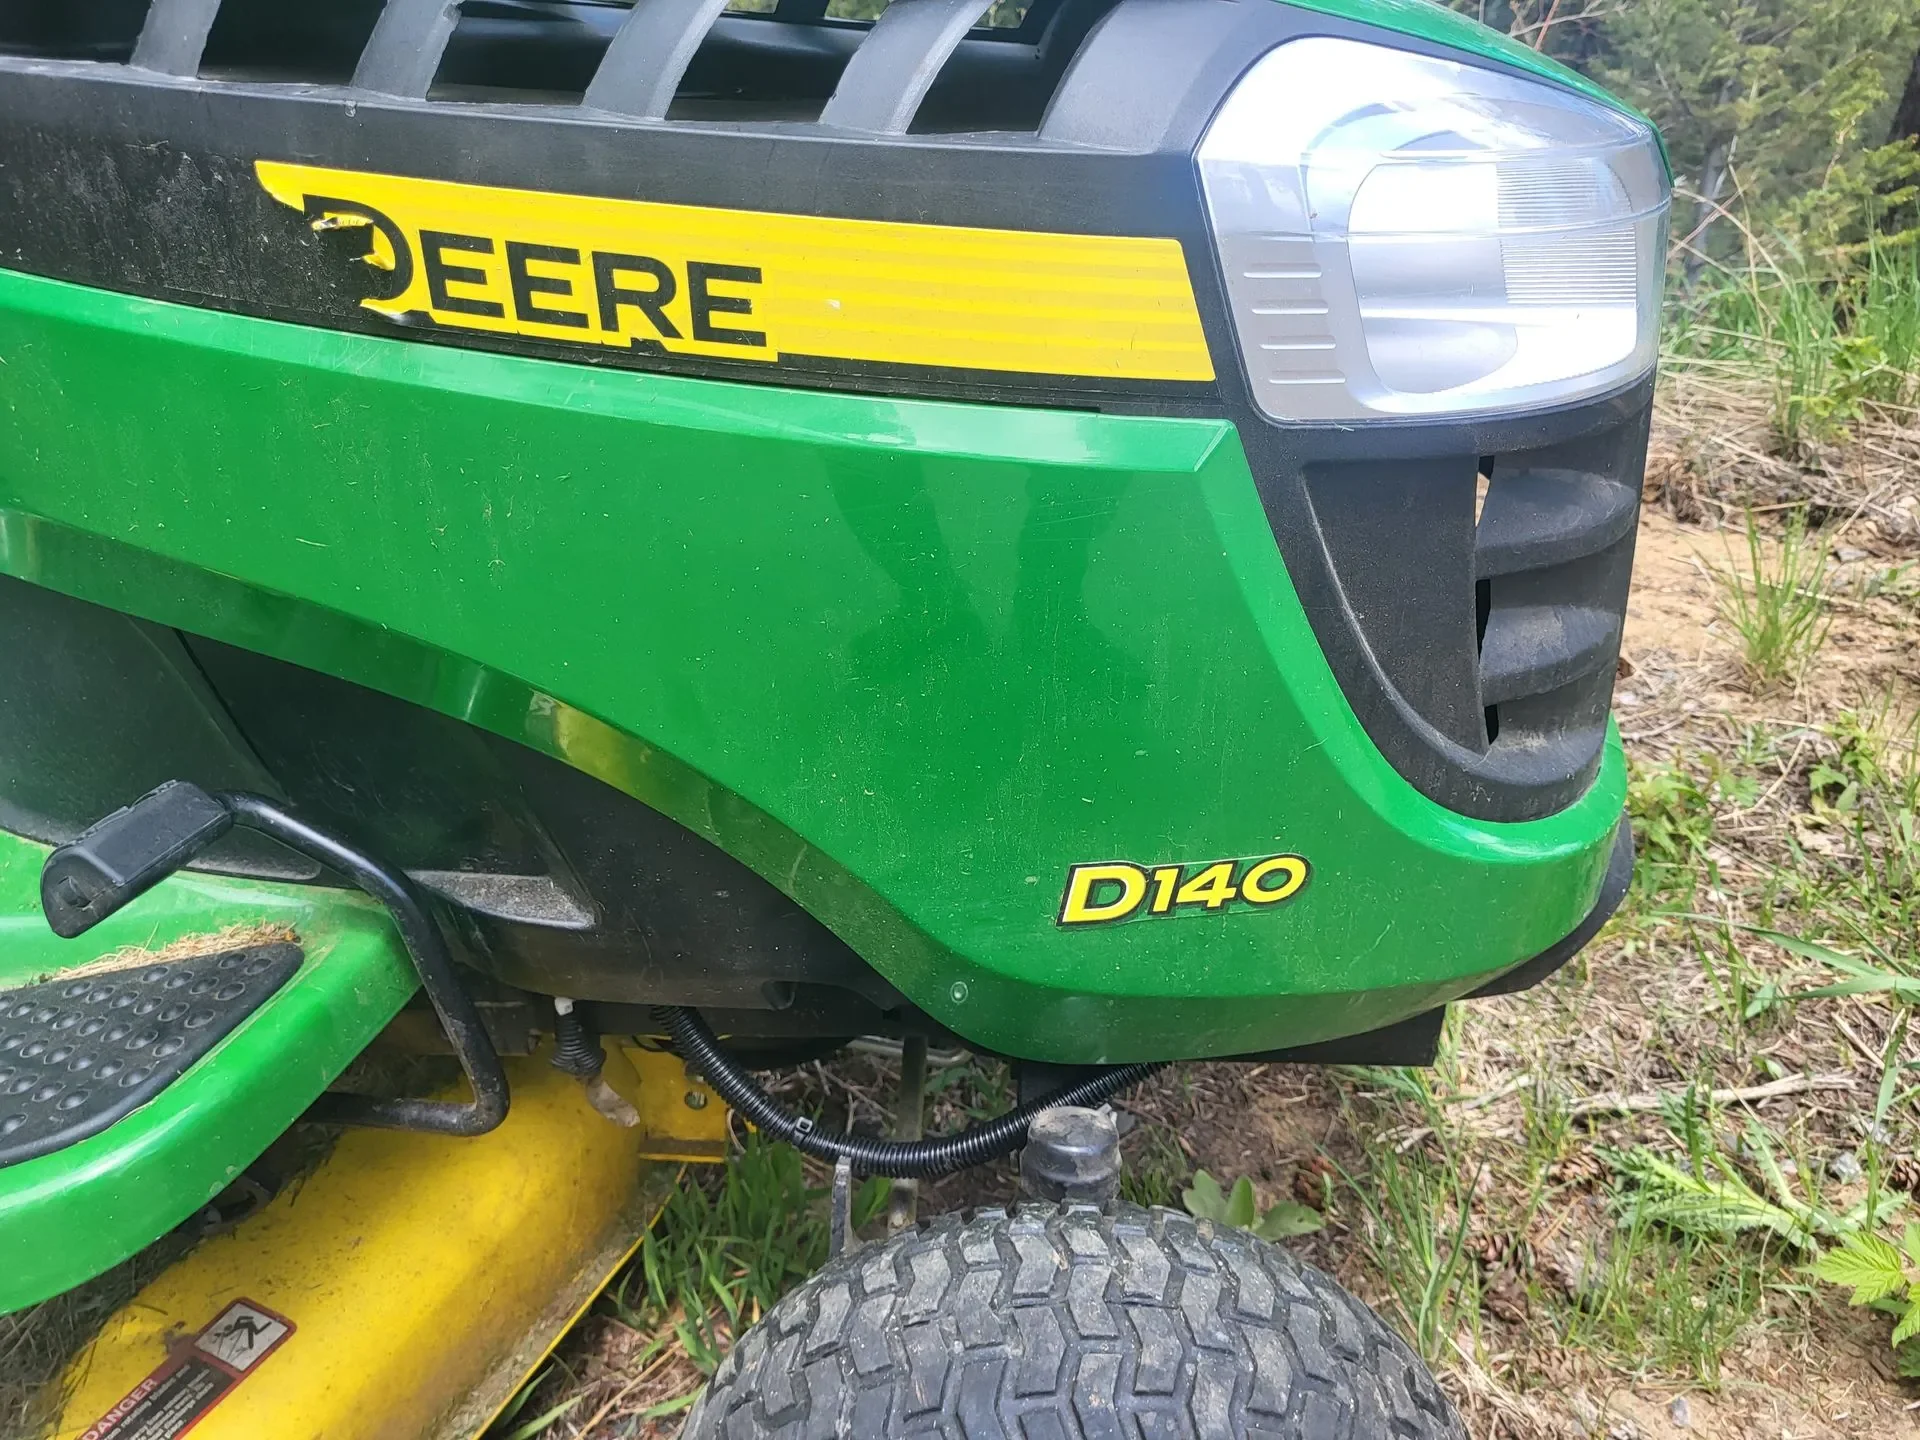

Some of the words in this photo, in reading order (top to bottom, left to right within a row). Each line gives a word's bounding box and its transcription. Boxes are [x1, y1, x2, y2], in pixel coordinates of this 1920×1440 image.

[303, 194, 767, 347] DEERE
[1057, 854, 1311, 926] D140
[82, 1378, 157, 1440] DANGER
